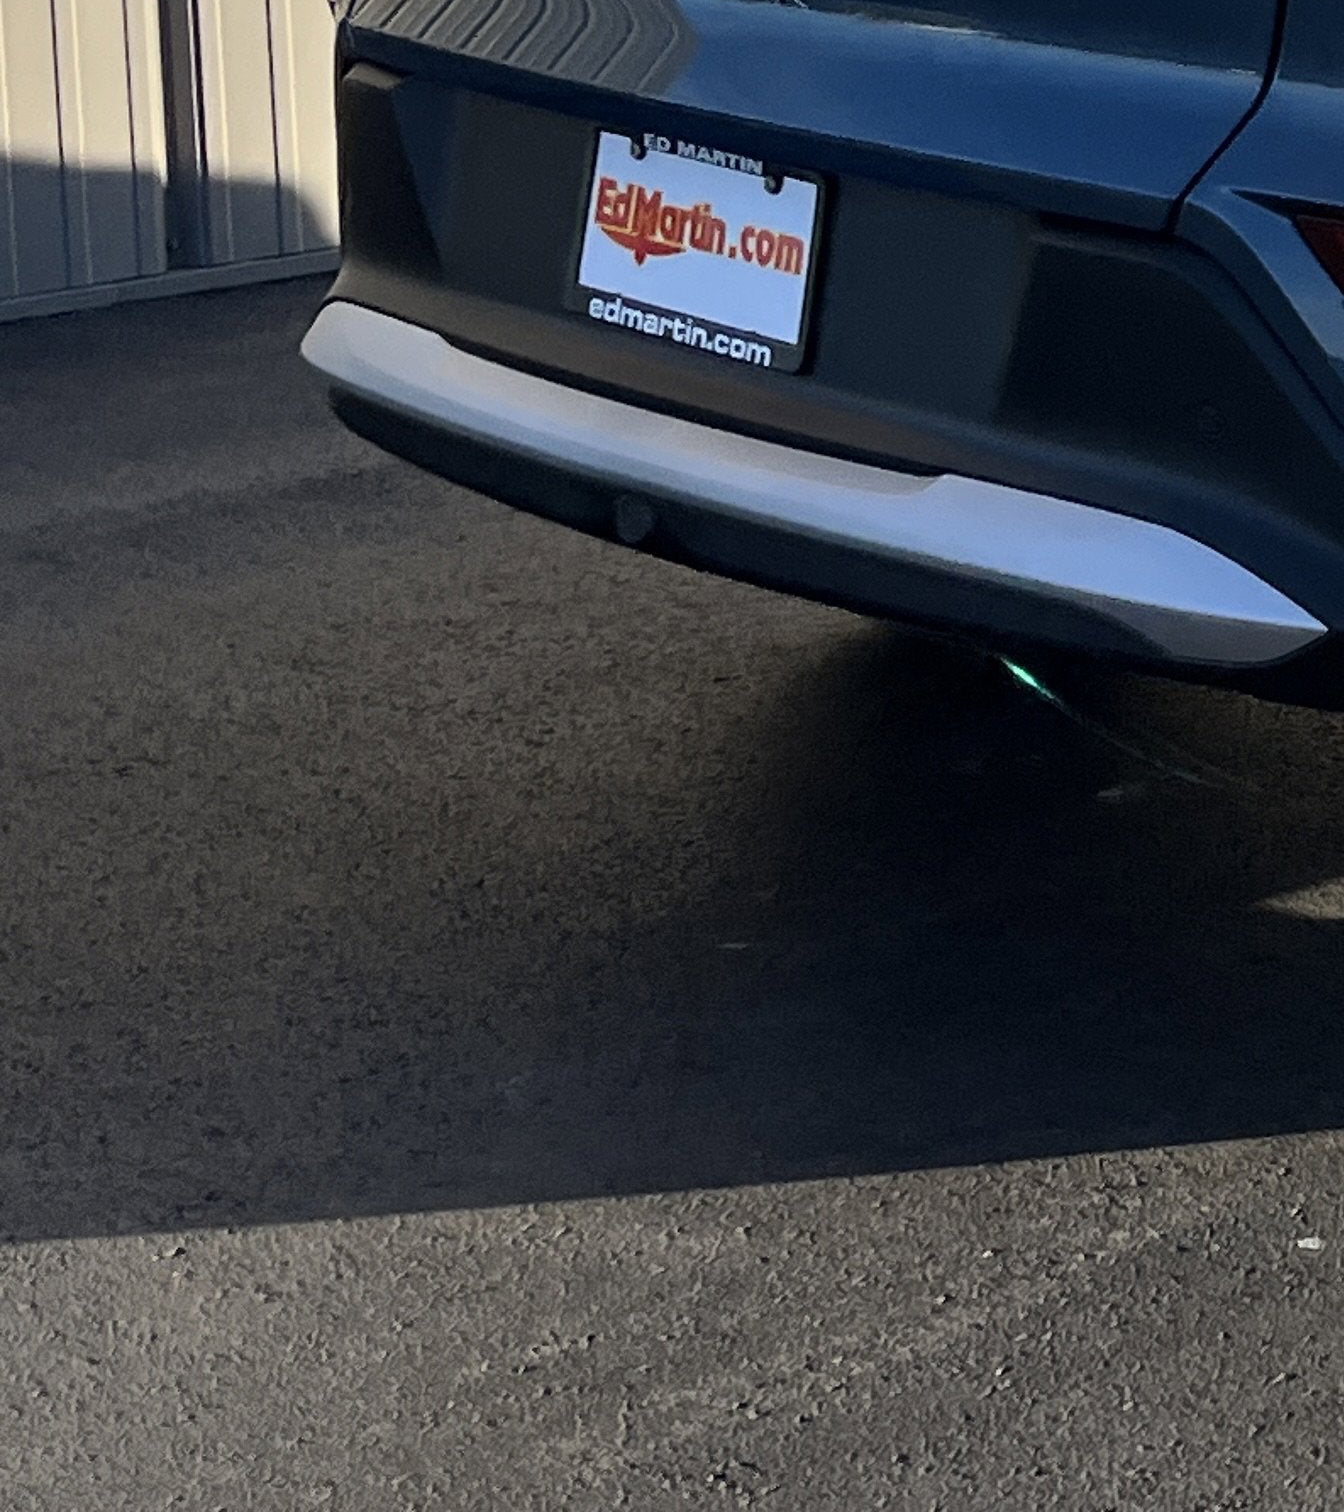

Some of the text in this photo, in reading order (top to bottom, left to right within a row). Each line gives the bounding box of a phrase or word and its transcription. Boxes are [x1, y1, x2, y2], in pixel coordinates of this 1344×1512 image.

[643, 133, 763, 176] ED MARTIN
[595, 176, 804, 275] EdMartin.com
[588, 297, 772, 367] edmartin.com
